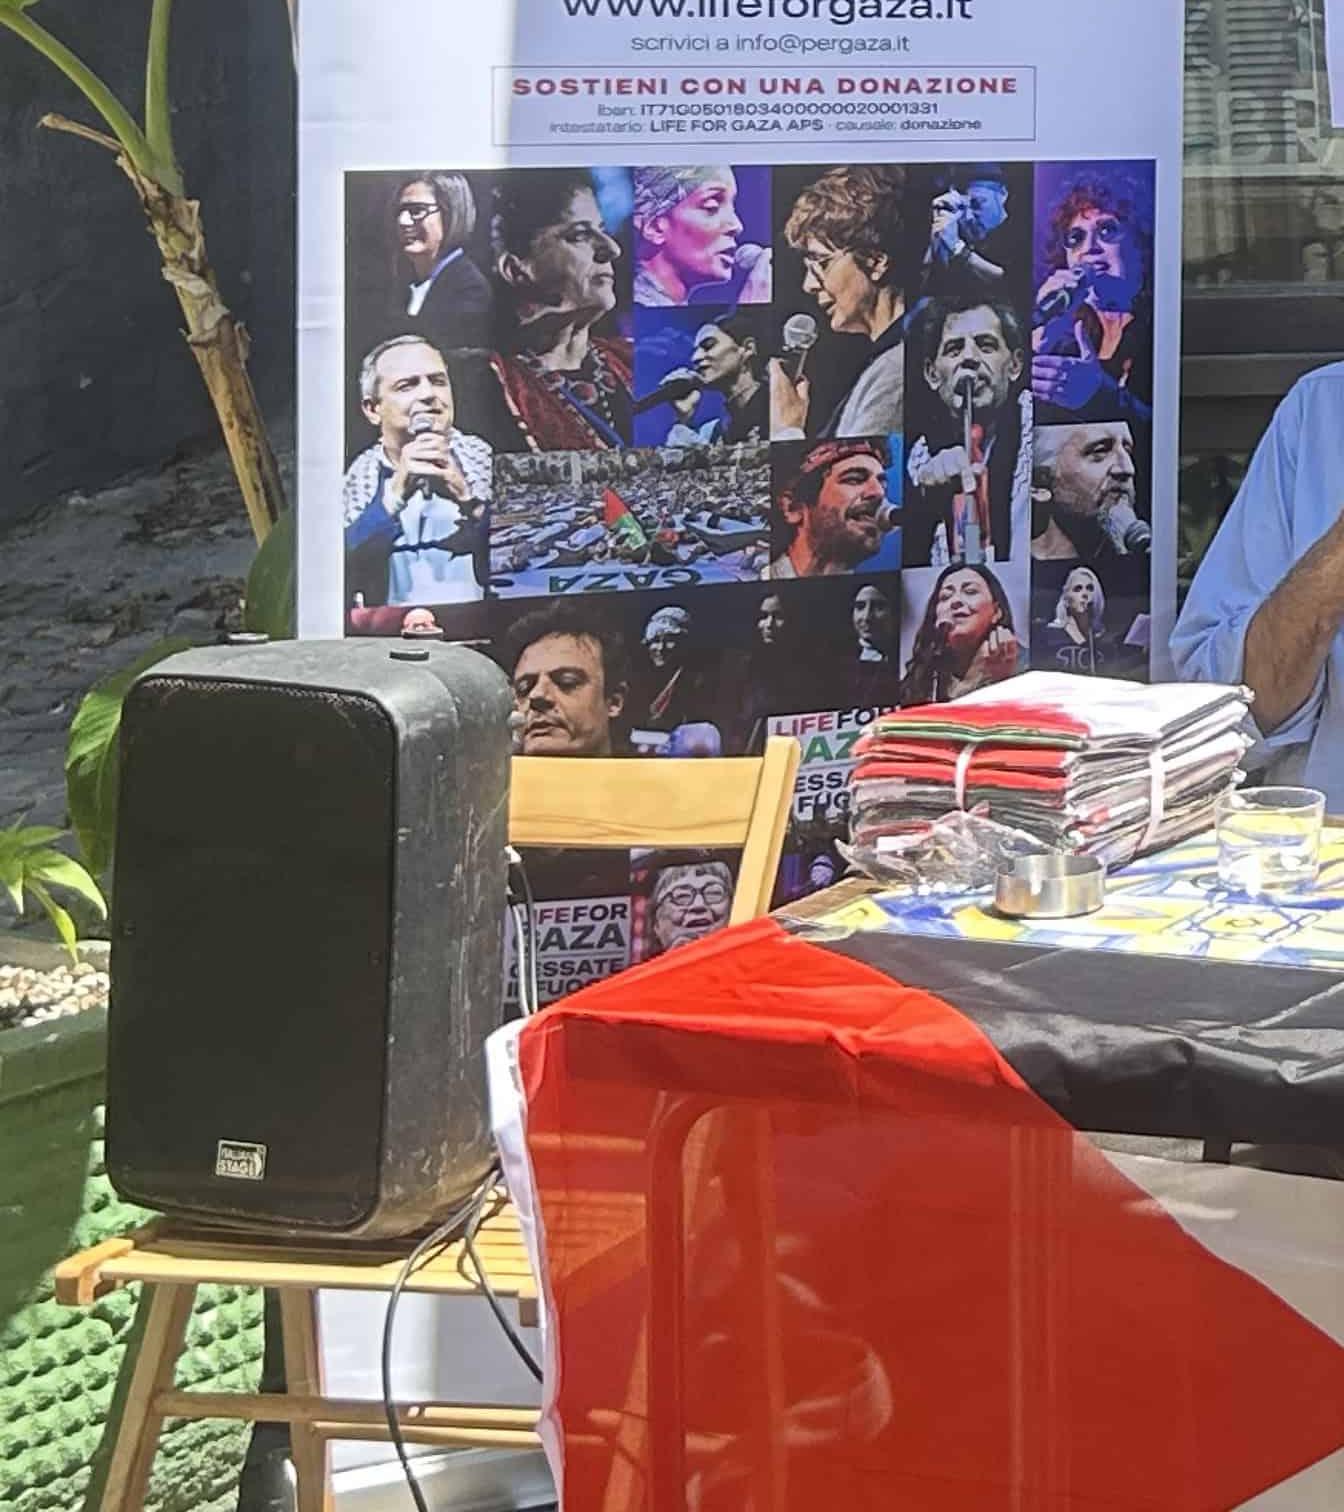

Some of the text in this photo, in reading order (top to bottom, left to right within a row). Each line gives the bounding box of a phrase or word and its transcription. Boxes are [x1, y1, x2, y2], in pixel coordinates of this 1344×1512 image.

[631, 34, 910, 55] scrivici a info@pergaza.it
[512, 77, 1018, 95] SOSTIENI CON UNA DONAZIONE
[649, 120, 687, 133] LIFE
[691, 119, 727, 133] FOR
[732, 119, 784, 133] GAZA
[788, 119, 824, 132] APS
[900, 118, 982, 131] donazione
